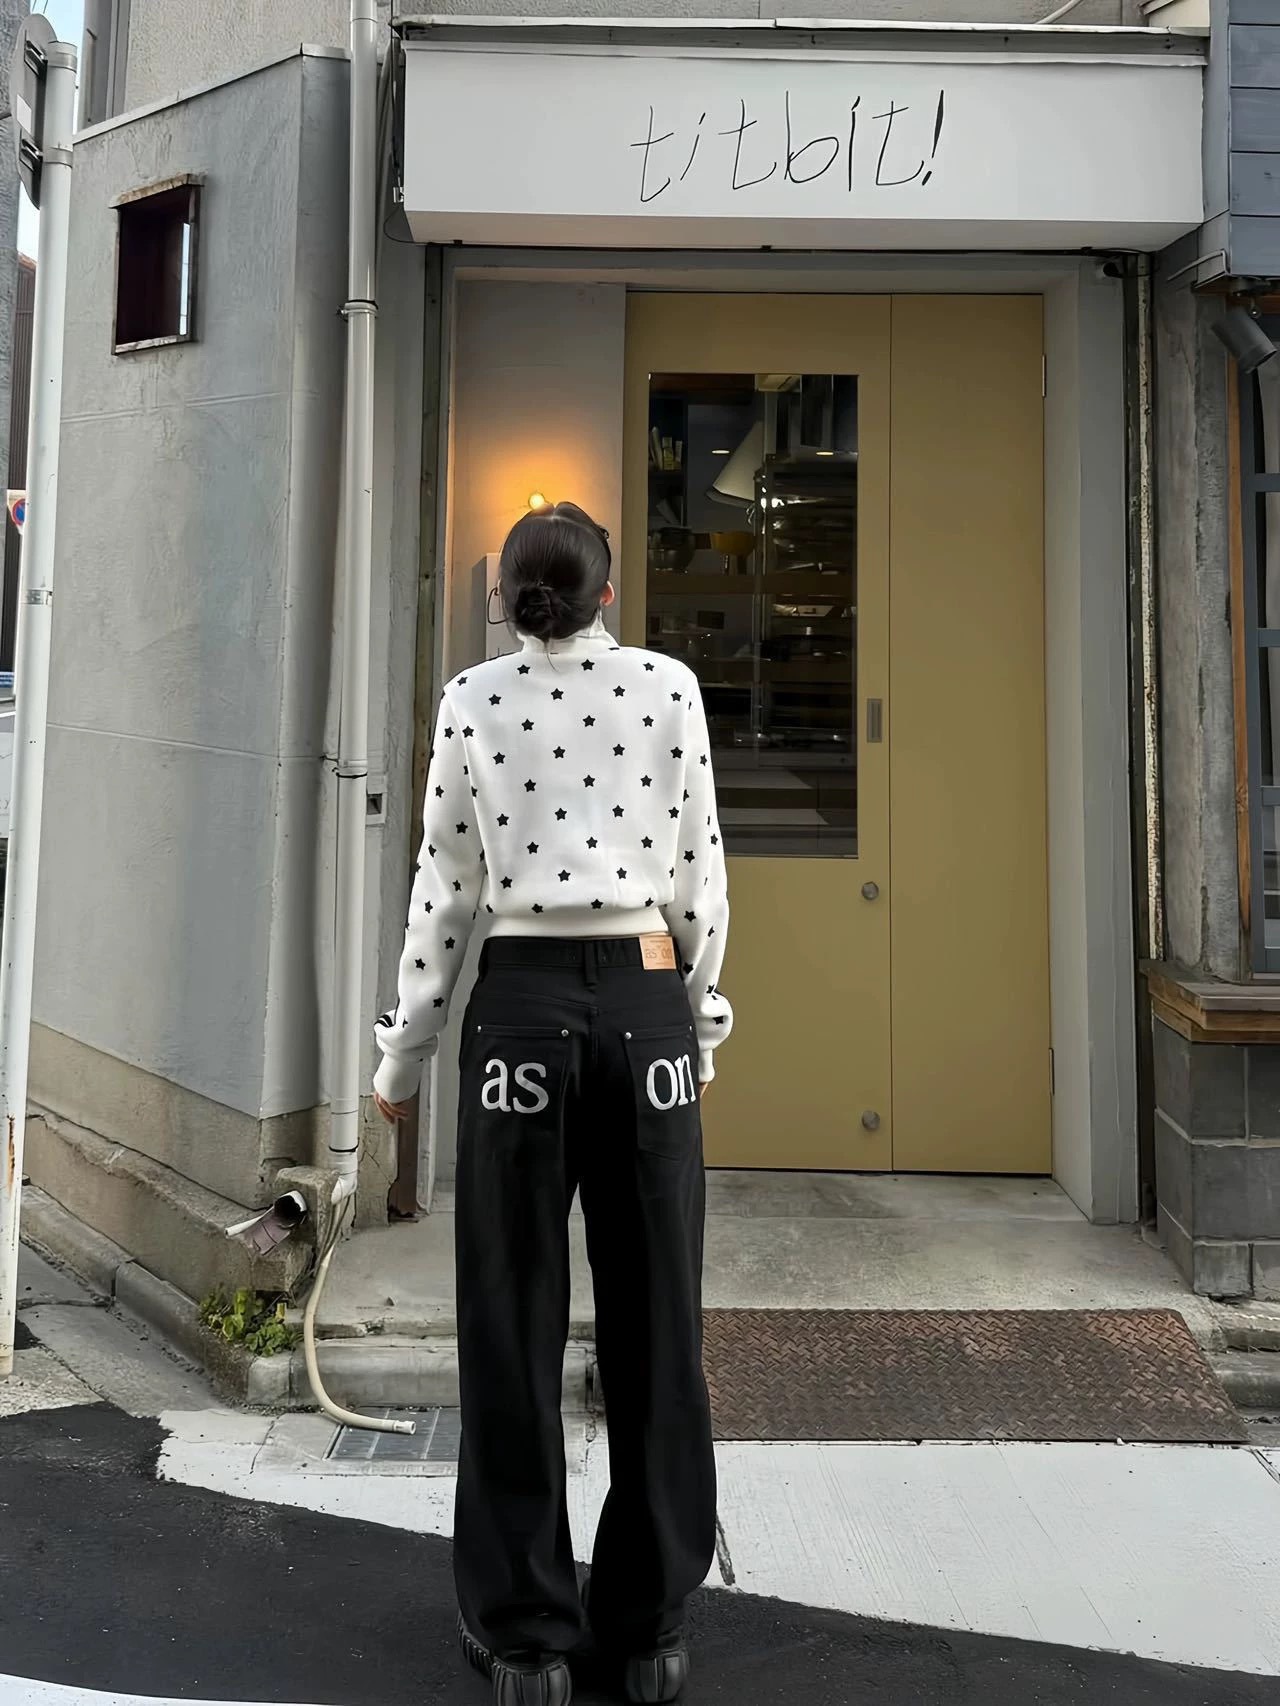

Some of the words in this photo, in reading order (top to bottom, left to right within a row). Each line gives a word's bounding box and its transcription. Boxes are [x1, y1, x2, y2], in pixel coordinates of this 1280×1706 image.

[630, 90, 945, 203] titbit!
[481, 1058, 549, 1114] as
[646, 1053, 697, 1111] on
